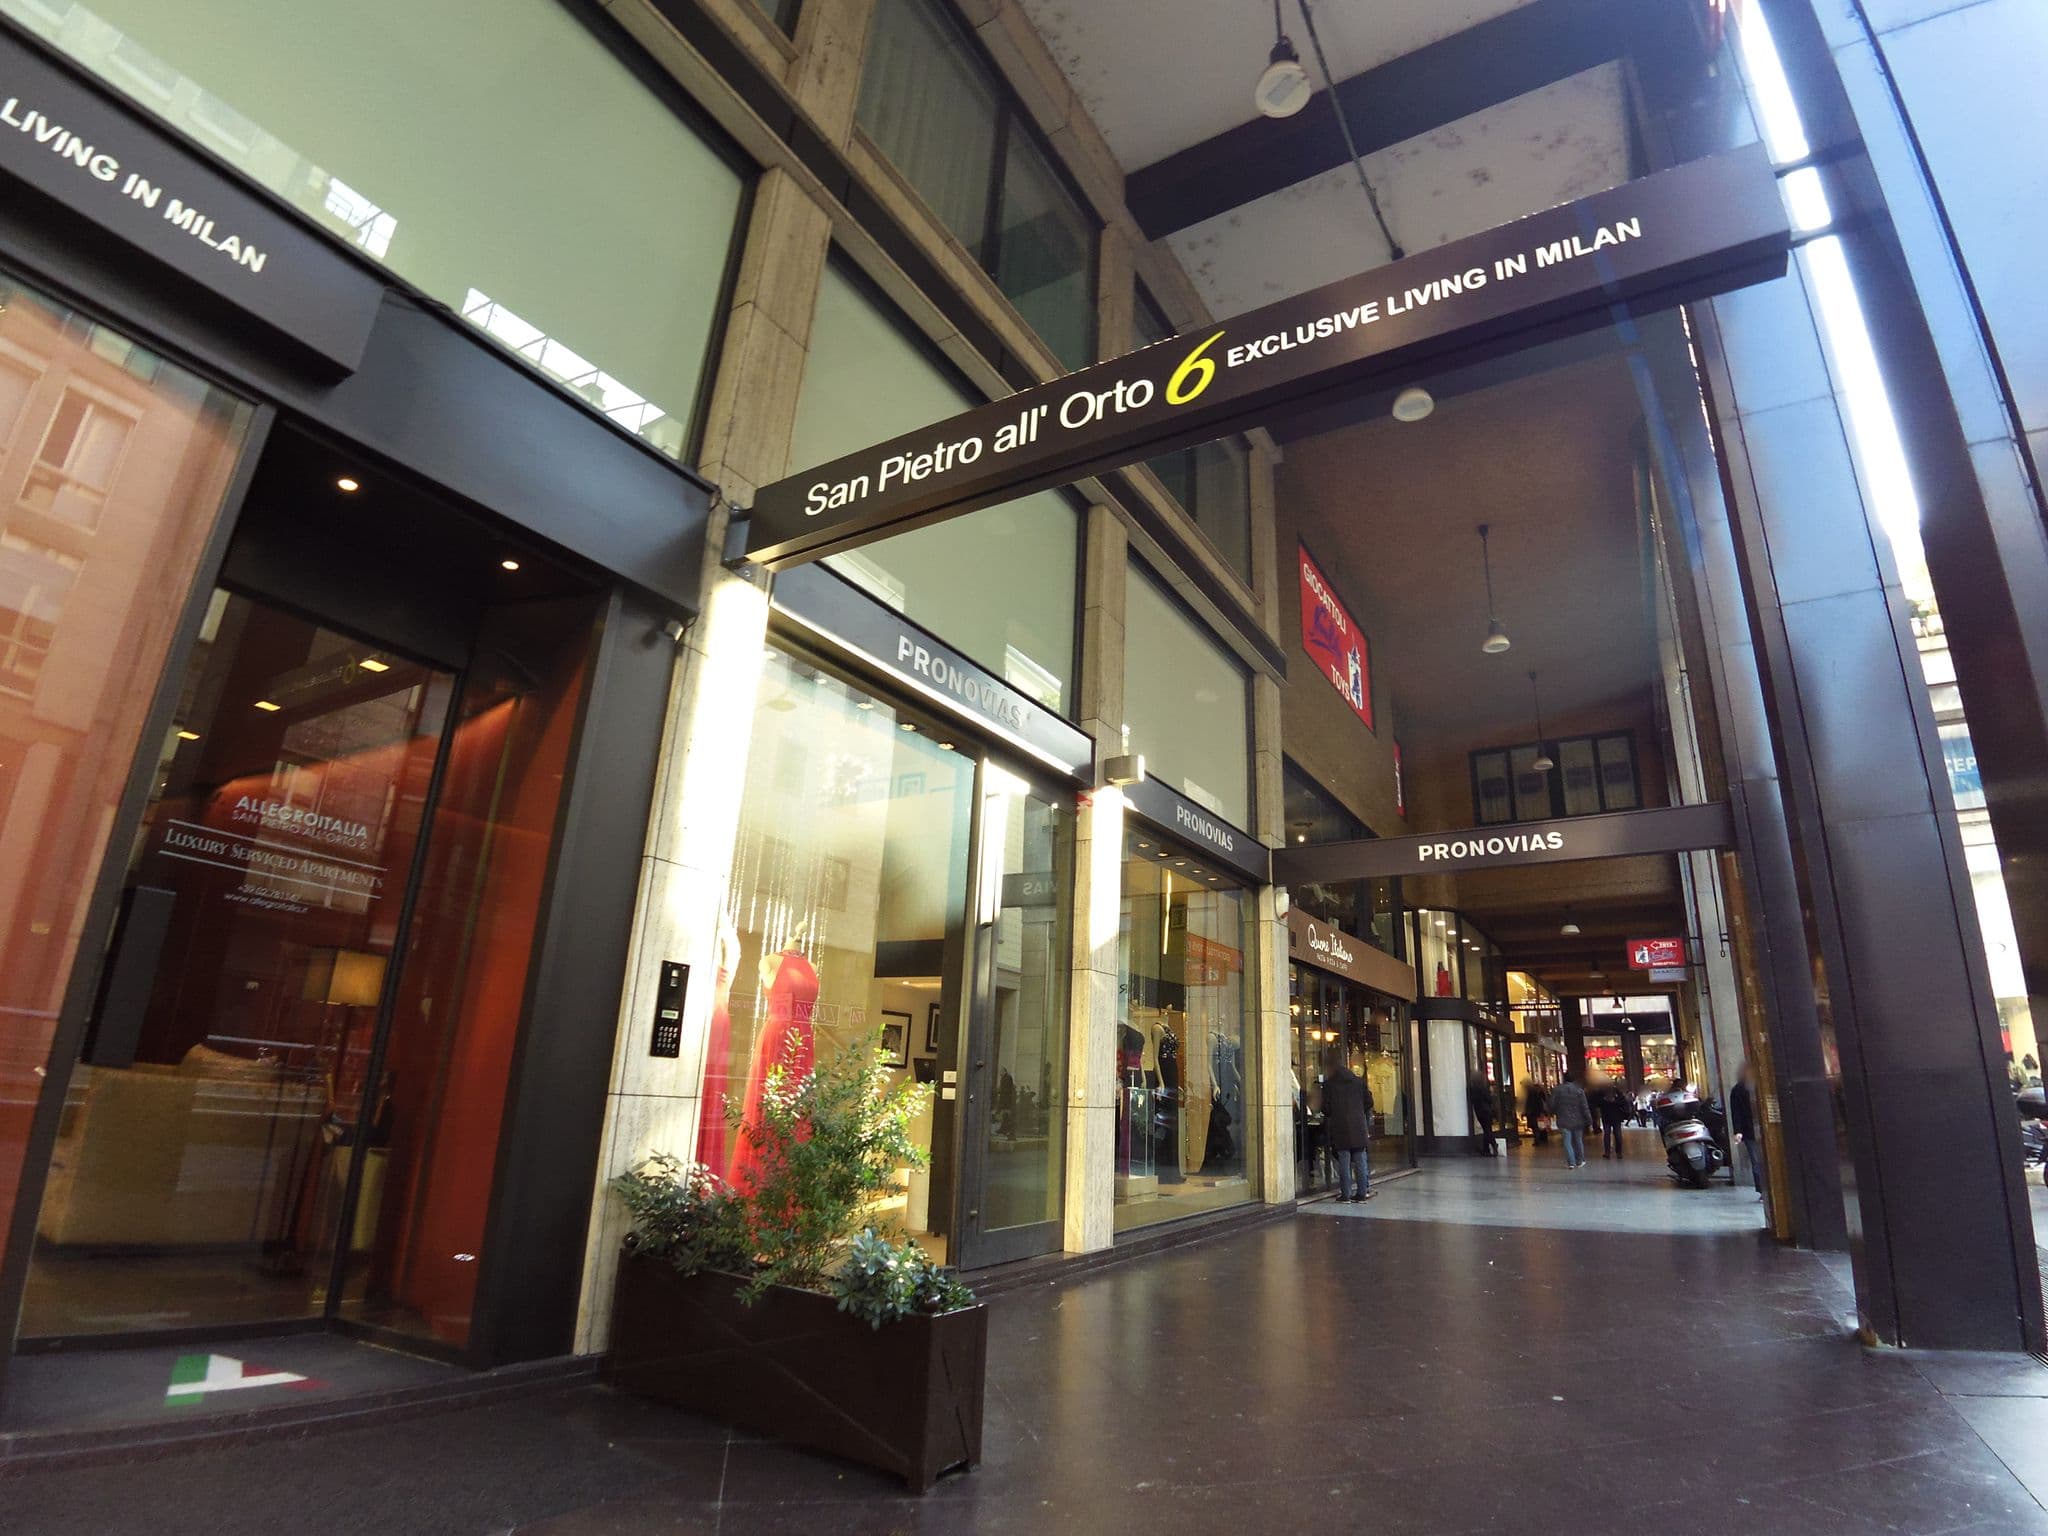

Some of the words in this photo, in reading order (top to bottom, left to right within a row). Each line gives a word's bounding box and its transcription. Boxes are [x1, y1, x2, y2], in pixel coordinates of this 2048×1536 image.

[0, 98, 120, 182] LIVING
[121, 173, 163, 209] IN
[163, 198, 268, 273] MILAN
[804, 473, 869, 517] San
[878, 436, 983, 493] Pietro
[993, 404, 1048, 453] all'
[1058, 378, 1155, 430] Orto
[1165, 330, 1226, 406] 6
[1226, 301, 1380, 369] EXCLUSIVE
[1386, 267, 1488, 317] LIVING
[1495, 254, 1527, 281] IN
[1535, 217, 1642, 268] MILAN
[1303, 563, 1347, 635] GIOCATTOLI
[897, 634, 1024, 730] PRONOVIAS
[1330, 664, 1351, 701] TOYS
[232, 810, 258, 825] SAN
[236, 796, 368, 839] ALLEGROITALIA
[1176, 804, 1234, 852] PRONOVIAS
[1418, 831, 1564, 862] PRONOVIAS
